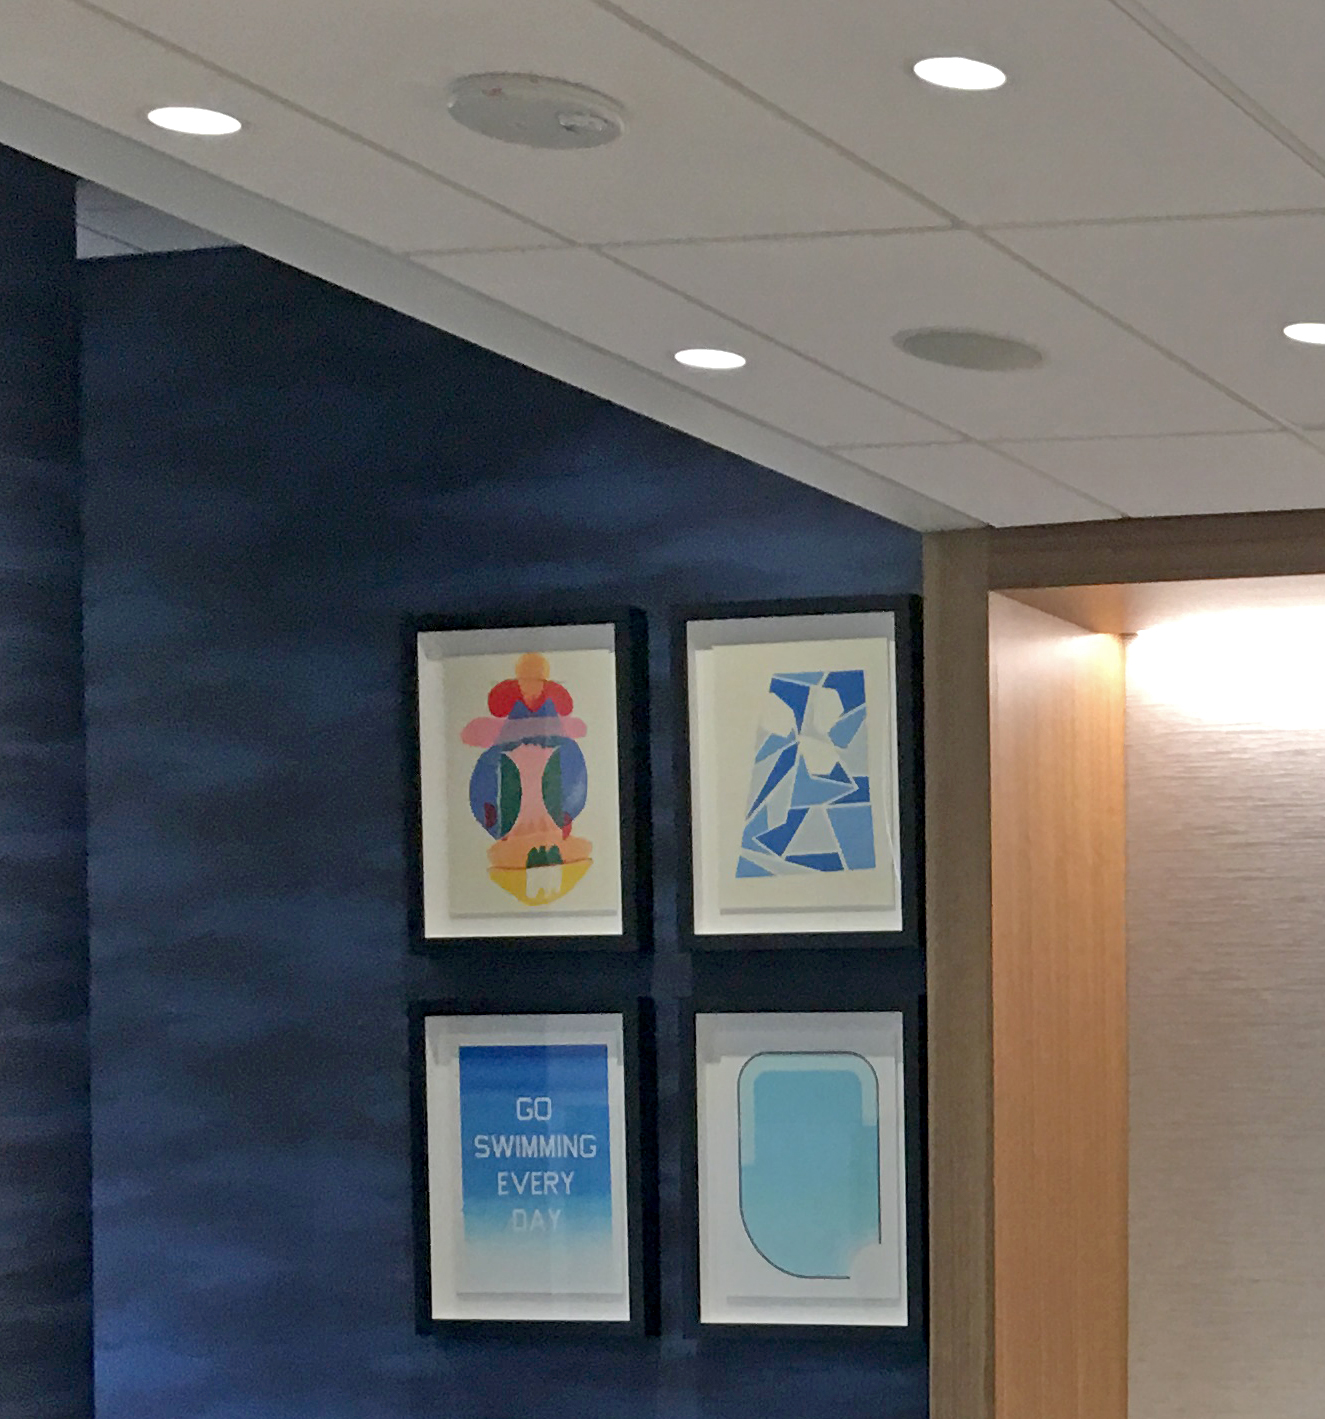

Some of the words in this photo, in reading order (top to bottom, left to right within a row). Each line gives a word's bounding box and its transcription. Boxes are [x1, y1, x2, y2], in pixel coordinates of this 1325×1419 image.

[516, 1097, 552, 1121] GO
[474, 1134, 597, 1158] SWIMMING
[497, 1171, 574, 1195] EVERY
[511, 1208, 562, 1232] DAY
